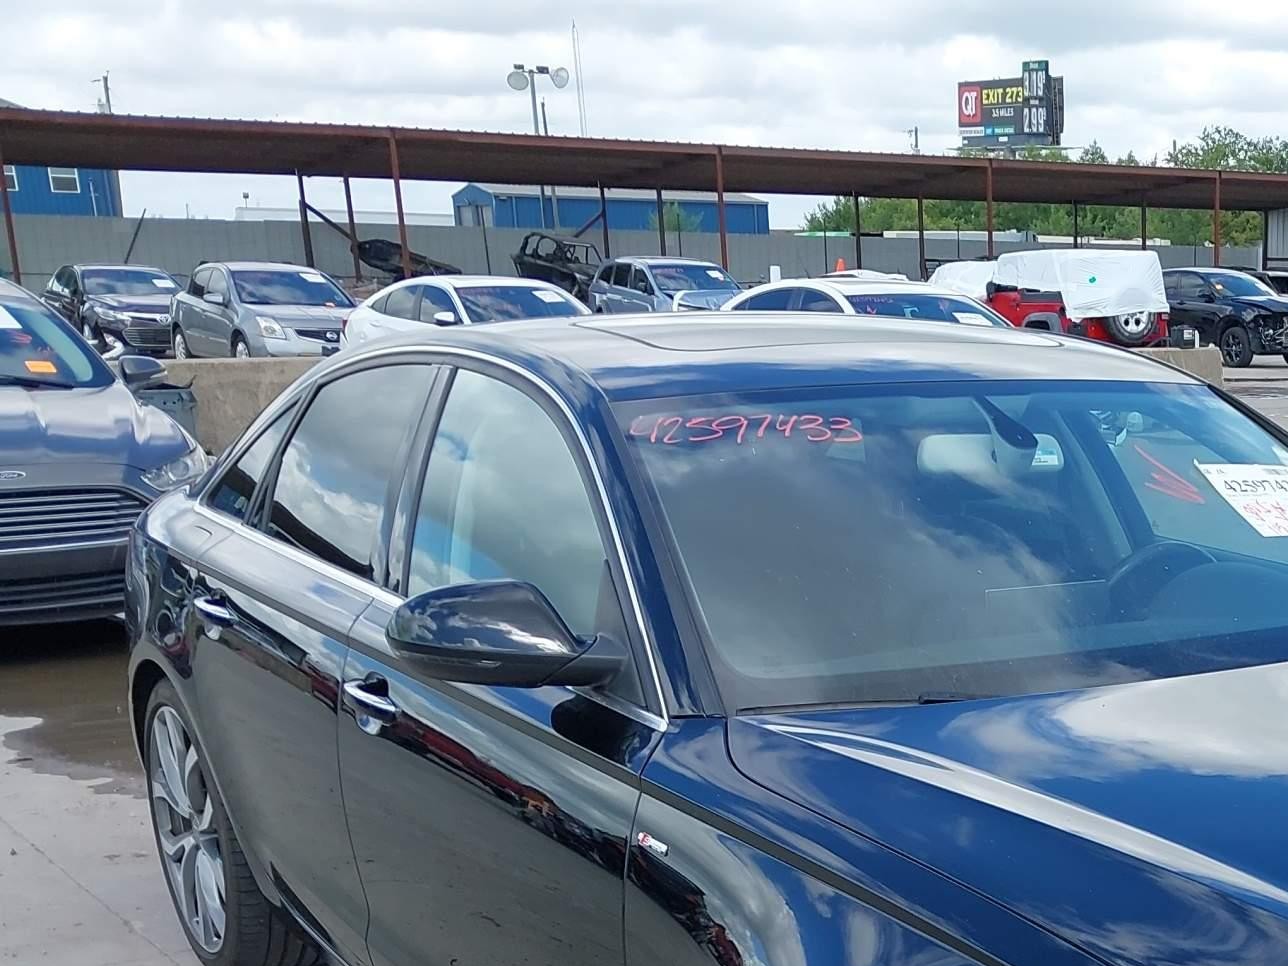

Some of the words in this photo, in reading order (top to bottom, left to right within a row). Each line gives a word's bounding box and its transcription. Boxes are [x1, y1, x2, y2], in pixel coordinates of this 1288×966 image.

[961, 91, 977, 118] QT
[982, 88, 1004, 105] EXIT
[1005, 86, 1023, 103] 273
[1000, 107, 1014, 117] MILES
[629, 413, 864, 445] 42597433
